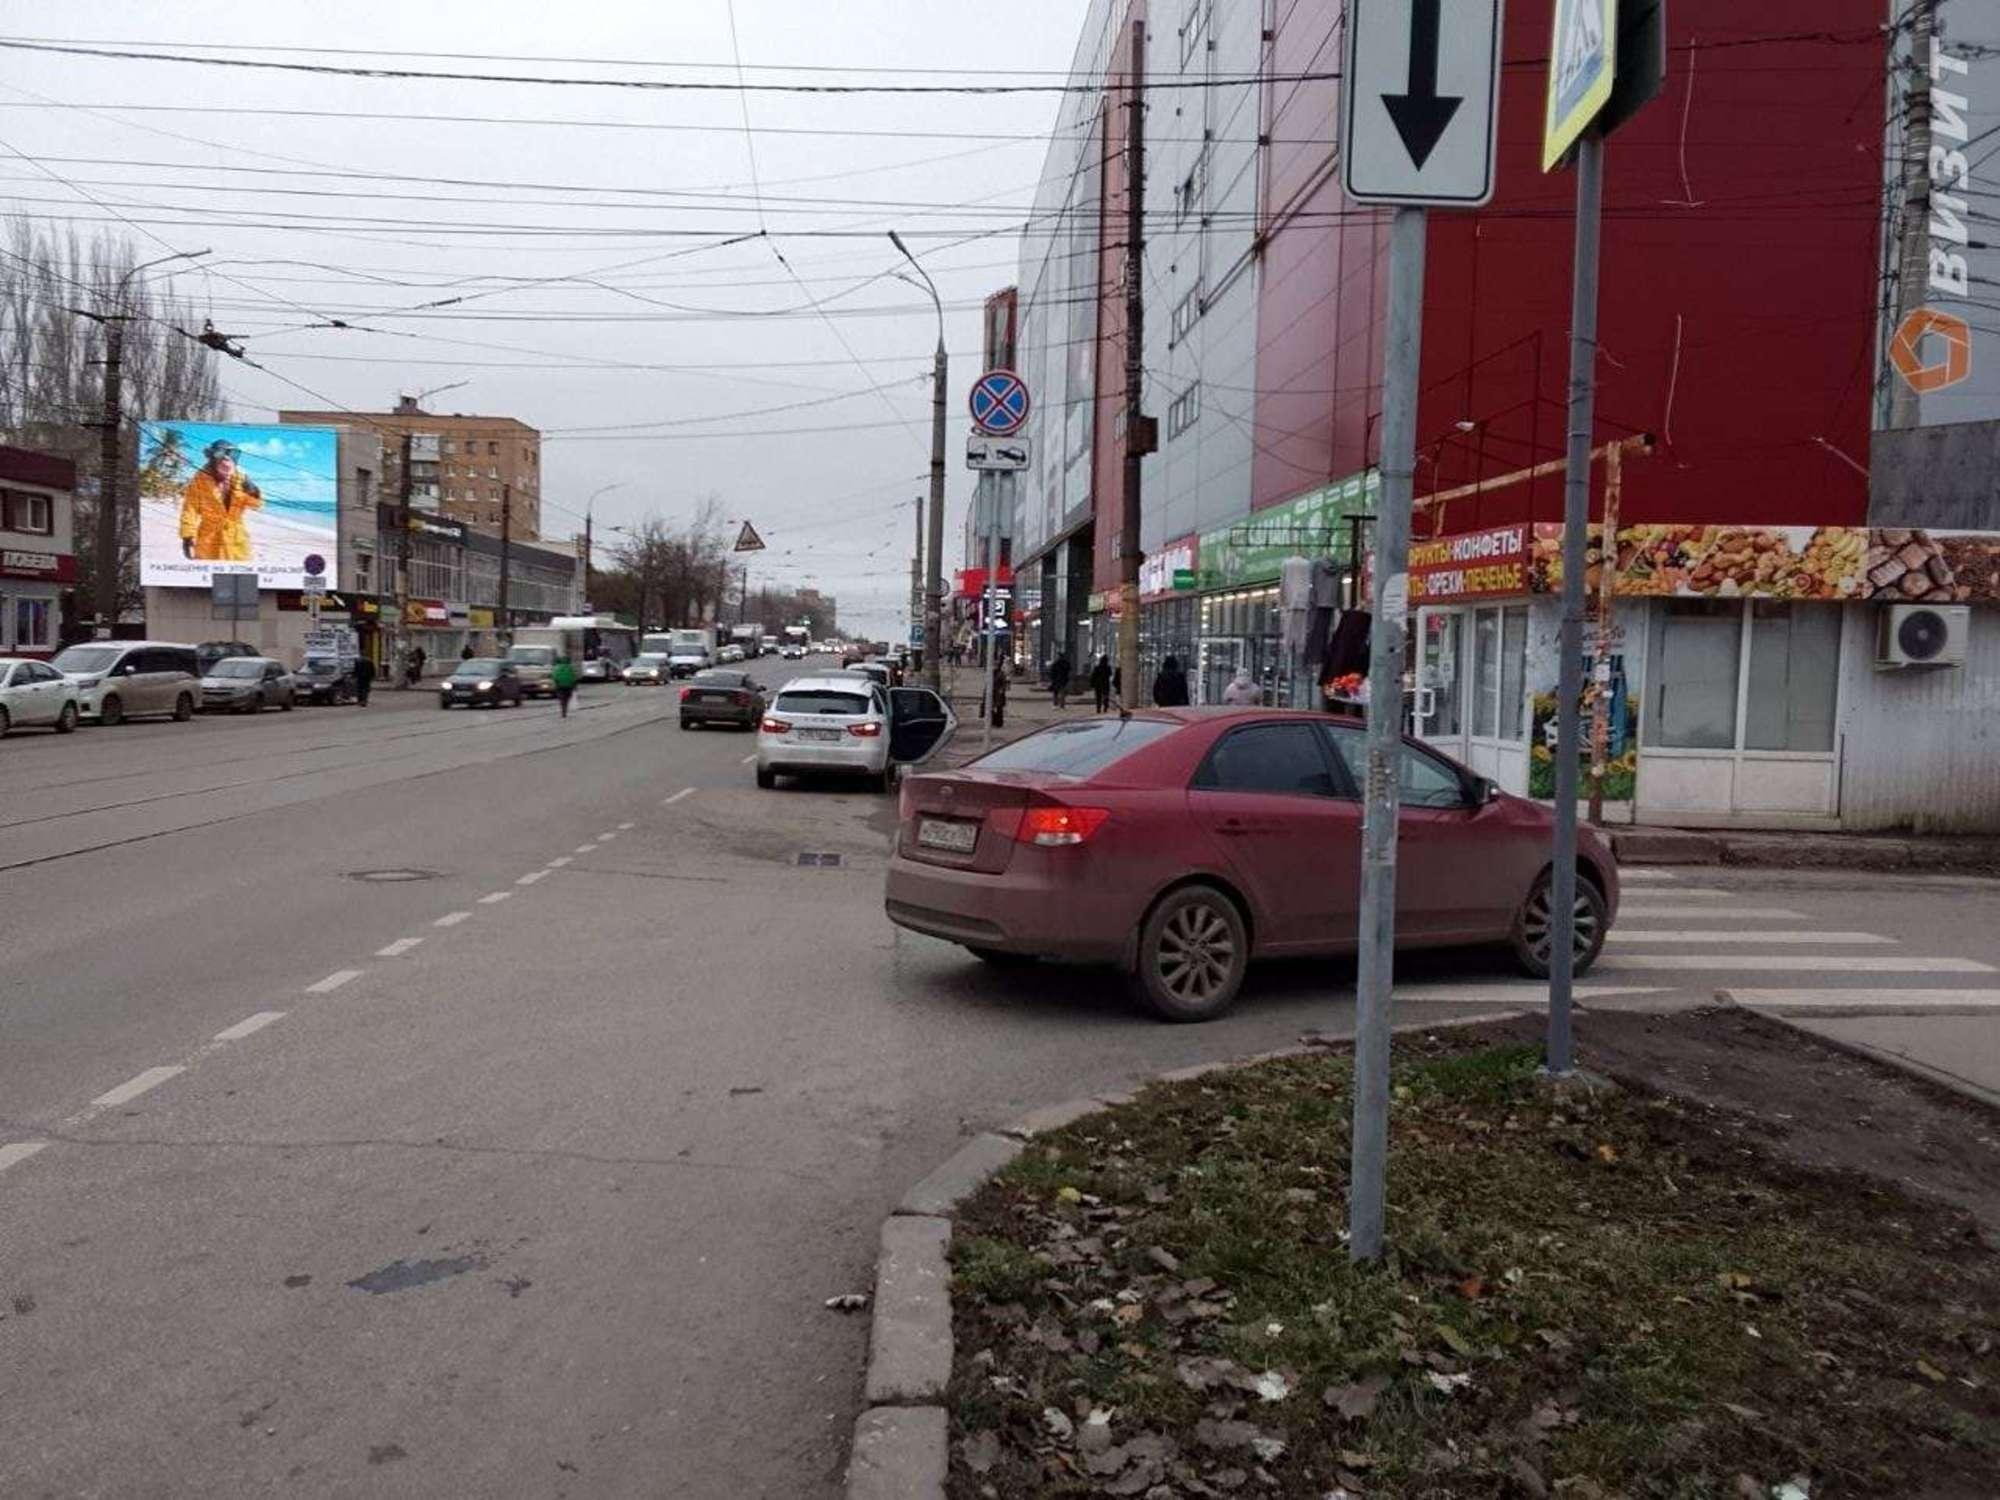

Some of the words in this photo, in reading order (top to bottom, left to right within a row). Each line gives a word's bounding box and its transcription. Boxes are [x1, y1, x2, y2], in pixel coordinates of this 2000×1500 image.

[1929, 35, 1968, 296] ВИЗИТ
[1453, 528, 1522, 560] КОНФЕТЫ
[1427, 569, 1464, 595] ОРЕХИ
[1466, 561, 1522, 592] ПЕЧЕНЬЕ
